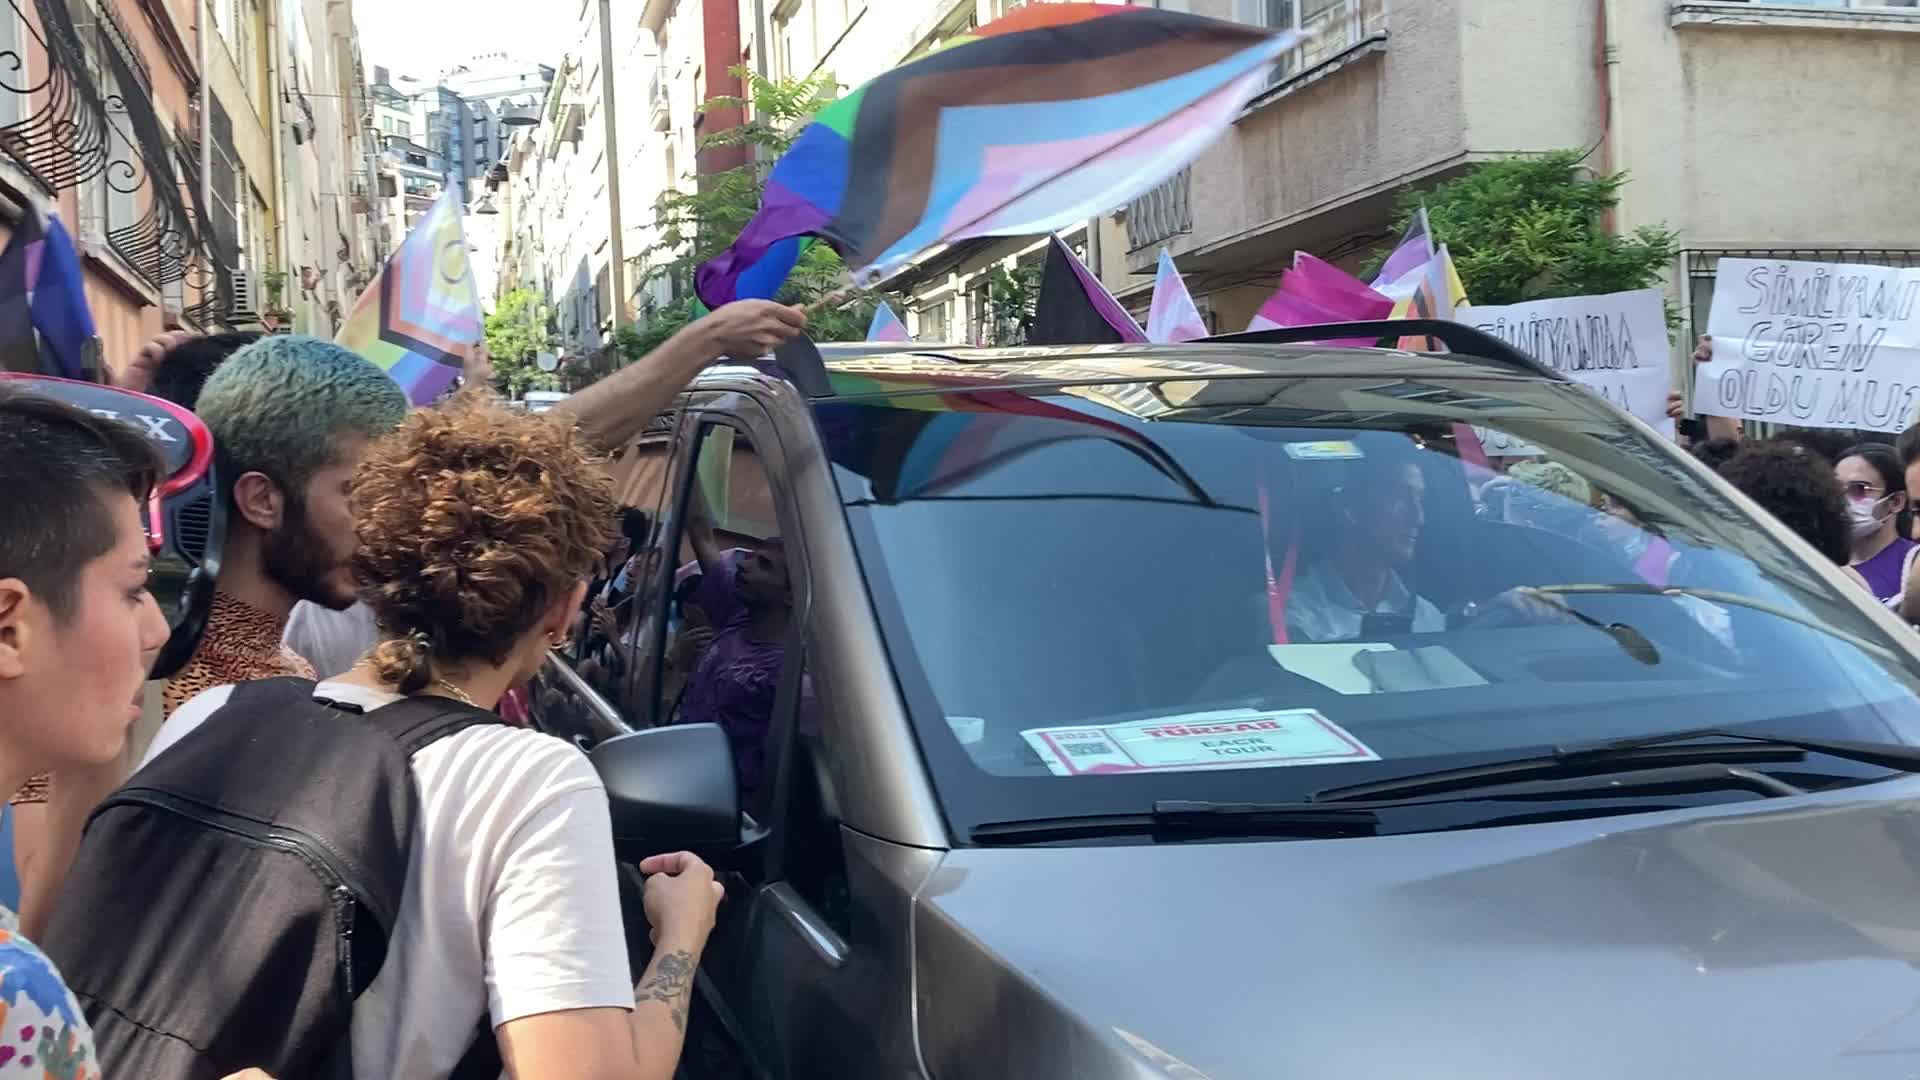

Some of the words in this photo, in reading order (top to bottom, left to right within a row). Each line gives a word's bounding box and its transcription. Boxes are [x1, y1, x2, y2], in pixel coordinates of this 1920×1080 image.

[1743, 319, 1887, 372] GÖREN
[1719, 369, 1823, 419] OLDU
[1826, 379, 1920, 431] MU?
[1209, 745, 1275, 755] TOUR
